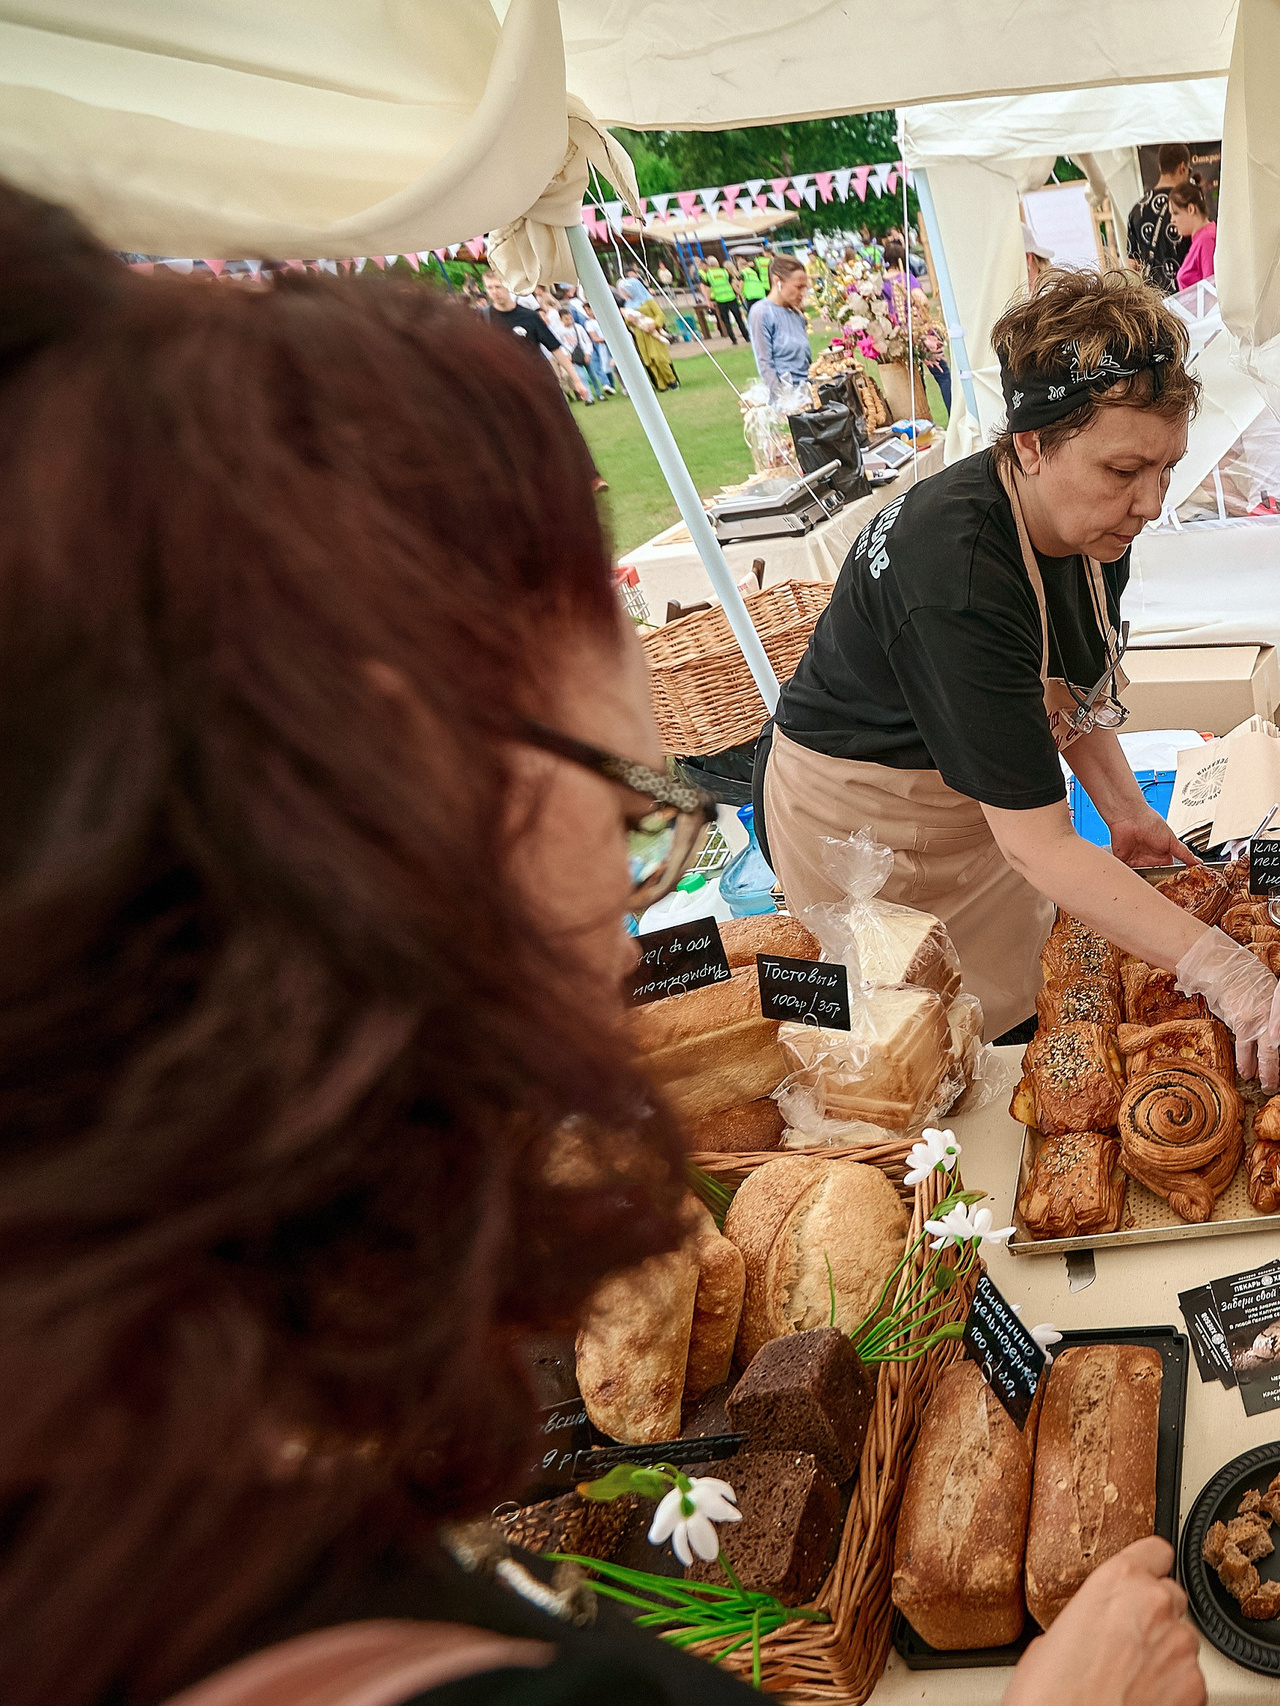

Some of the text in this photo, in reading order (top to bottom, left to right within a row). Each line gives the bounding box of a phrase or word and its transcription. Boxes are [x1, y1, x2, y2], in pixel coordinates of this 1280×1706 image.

[868, 494, 907, 579] ЛЕБОВ
[762, 961, 838, 988] Тостовый
[1233, 1281, 1261, 1293] ПЕКАРЬ
[1221, 1296, 1254, 1312] Забери
[1256, 1288, 1278, 1302] свой
